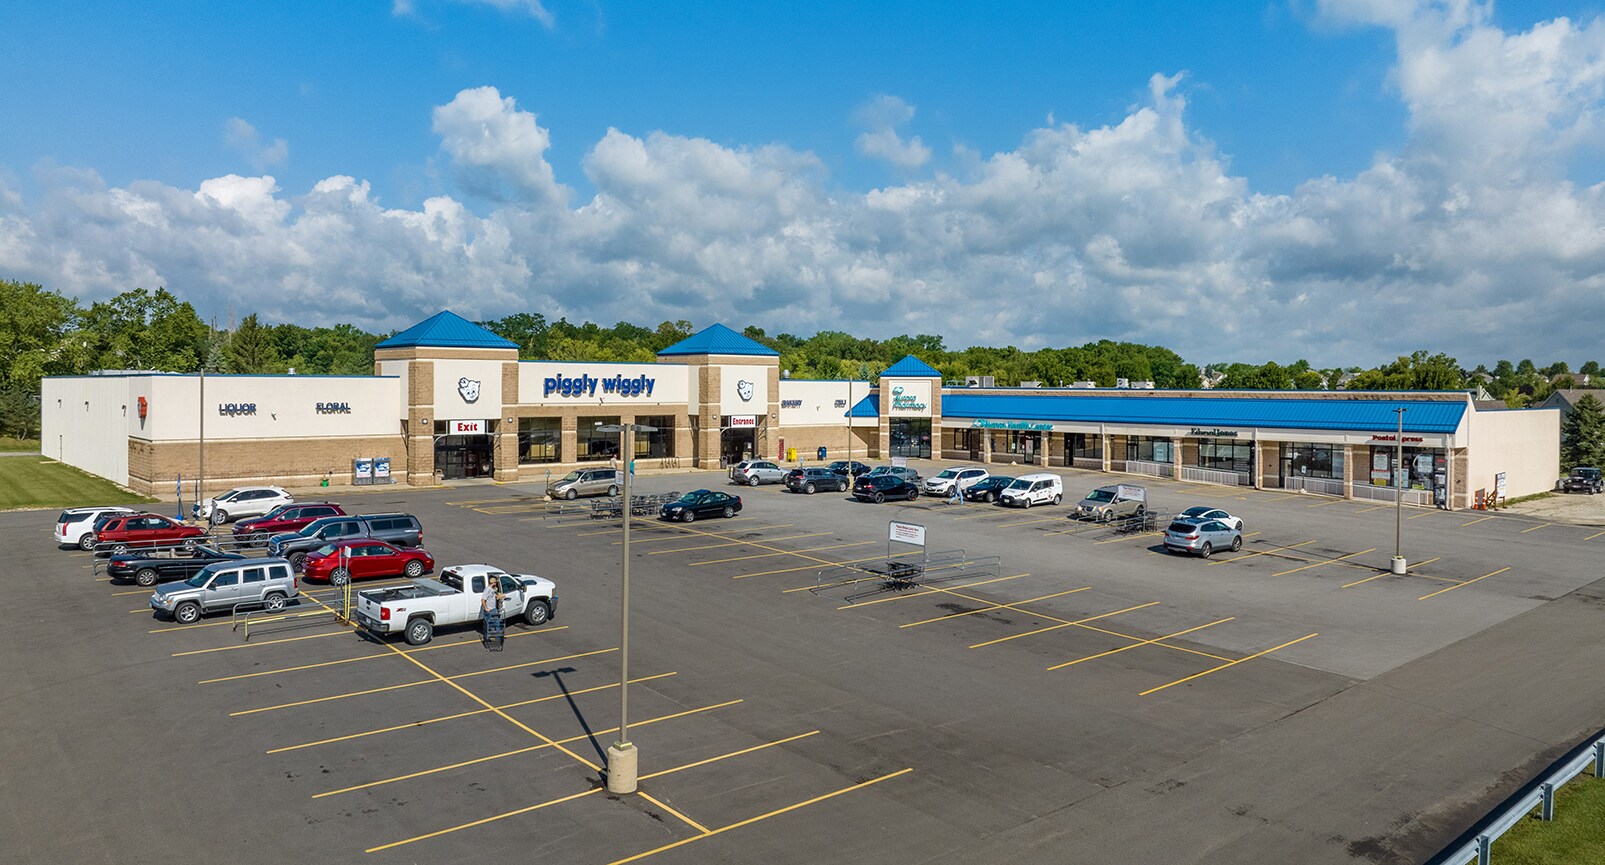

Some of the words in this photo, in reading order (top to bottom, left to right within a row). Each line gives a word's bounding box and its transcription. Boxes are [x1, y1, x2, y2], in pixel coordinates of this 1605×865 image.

[544, 374, 598, 397] piggly
[602, 375, 655, 397] wiggly
[219, 403, 257, 415] LIQUOR
[315, 402, 351, 412] FLORAL
[732, 417, 755, 425] Entrance
[457, 422, 478, 432] Exit
[1372, 434, 1396, 442] Postal
